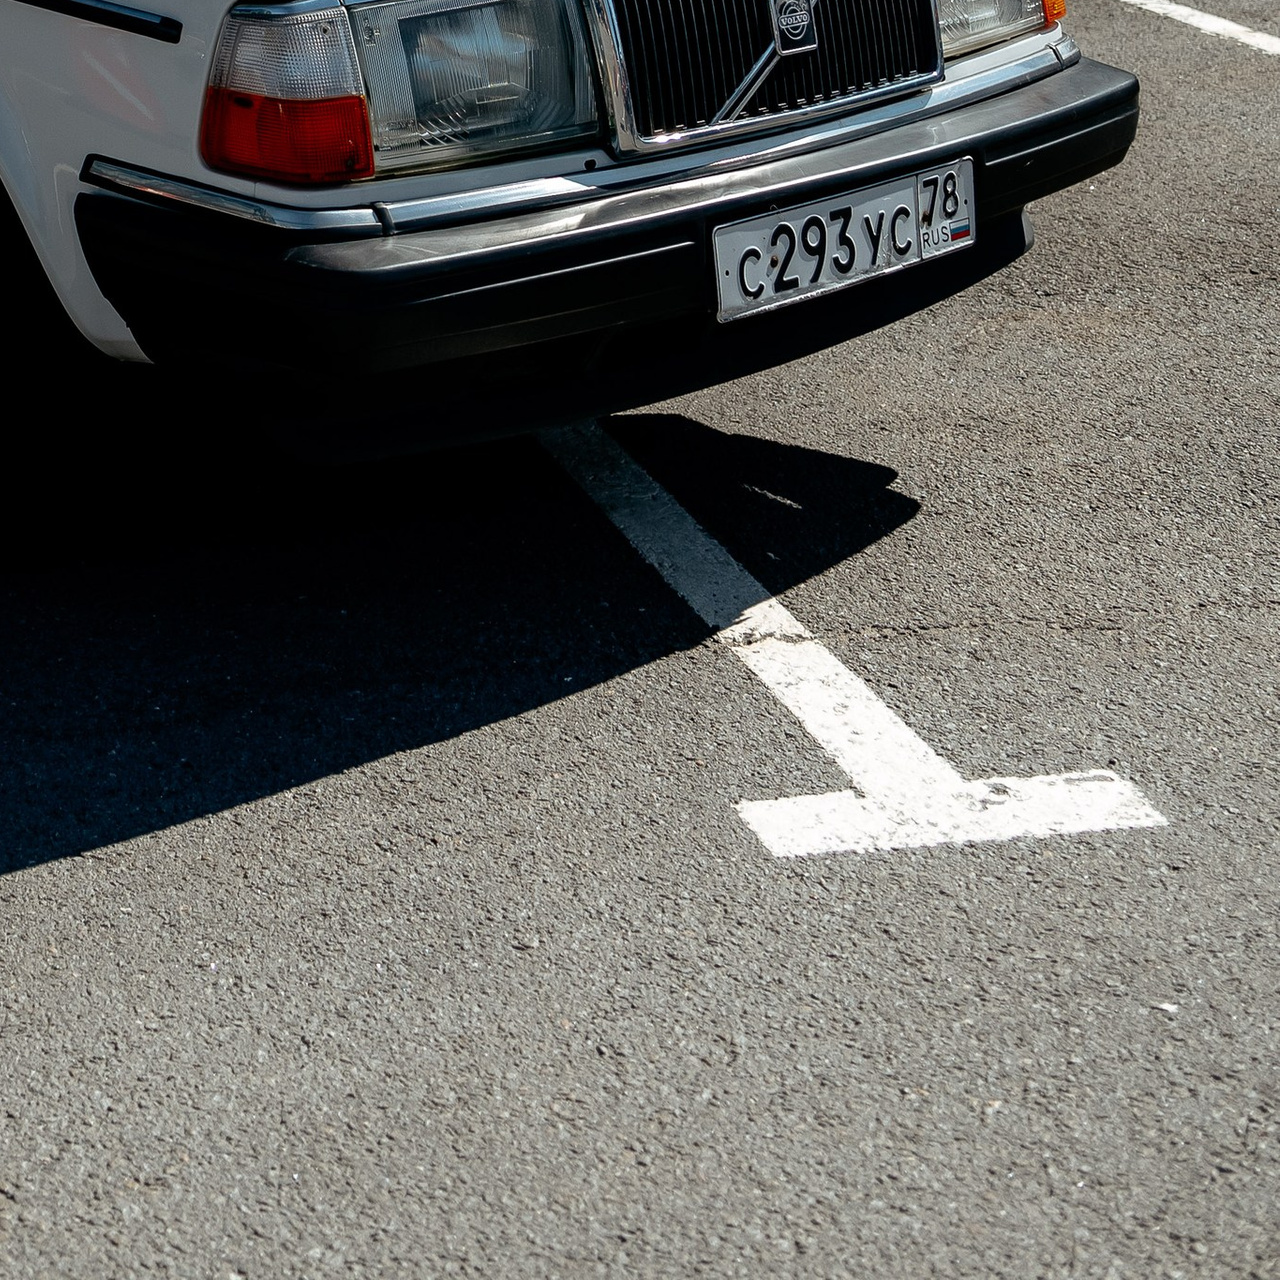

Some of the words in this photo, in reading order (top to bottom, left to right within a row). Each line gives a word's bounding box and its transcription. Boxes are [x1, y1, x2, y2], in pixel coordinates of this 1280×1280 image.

[781, 14, 808, 26] VOLVO
[922, 172, 959, 227] 78
[922, 226, 950, 249] RUS
